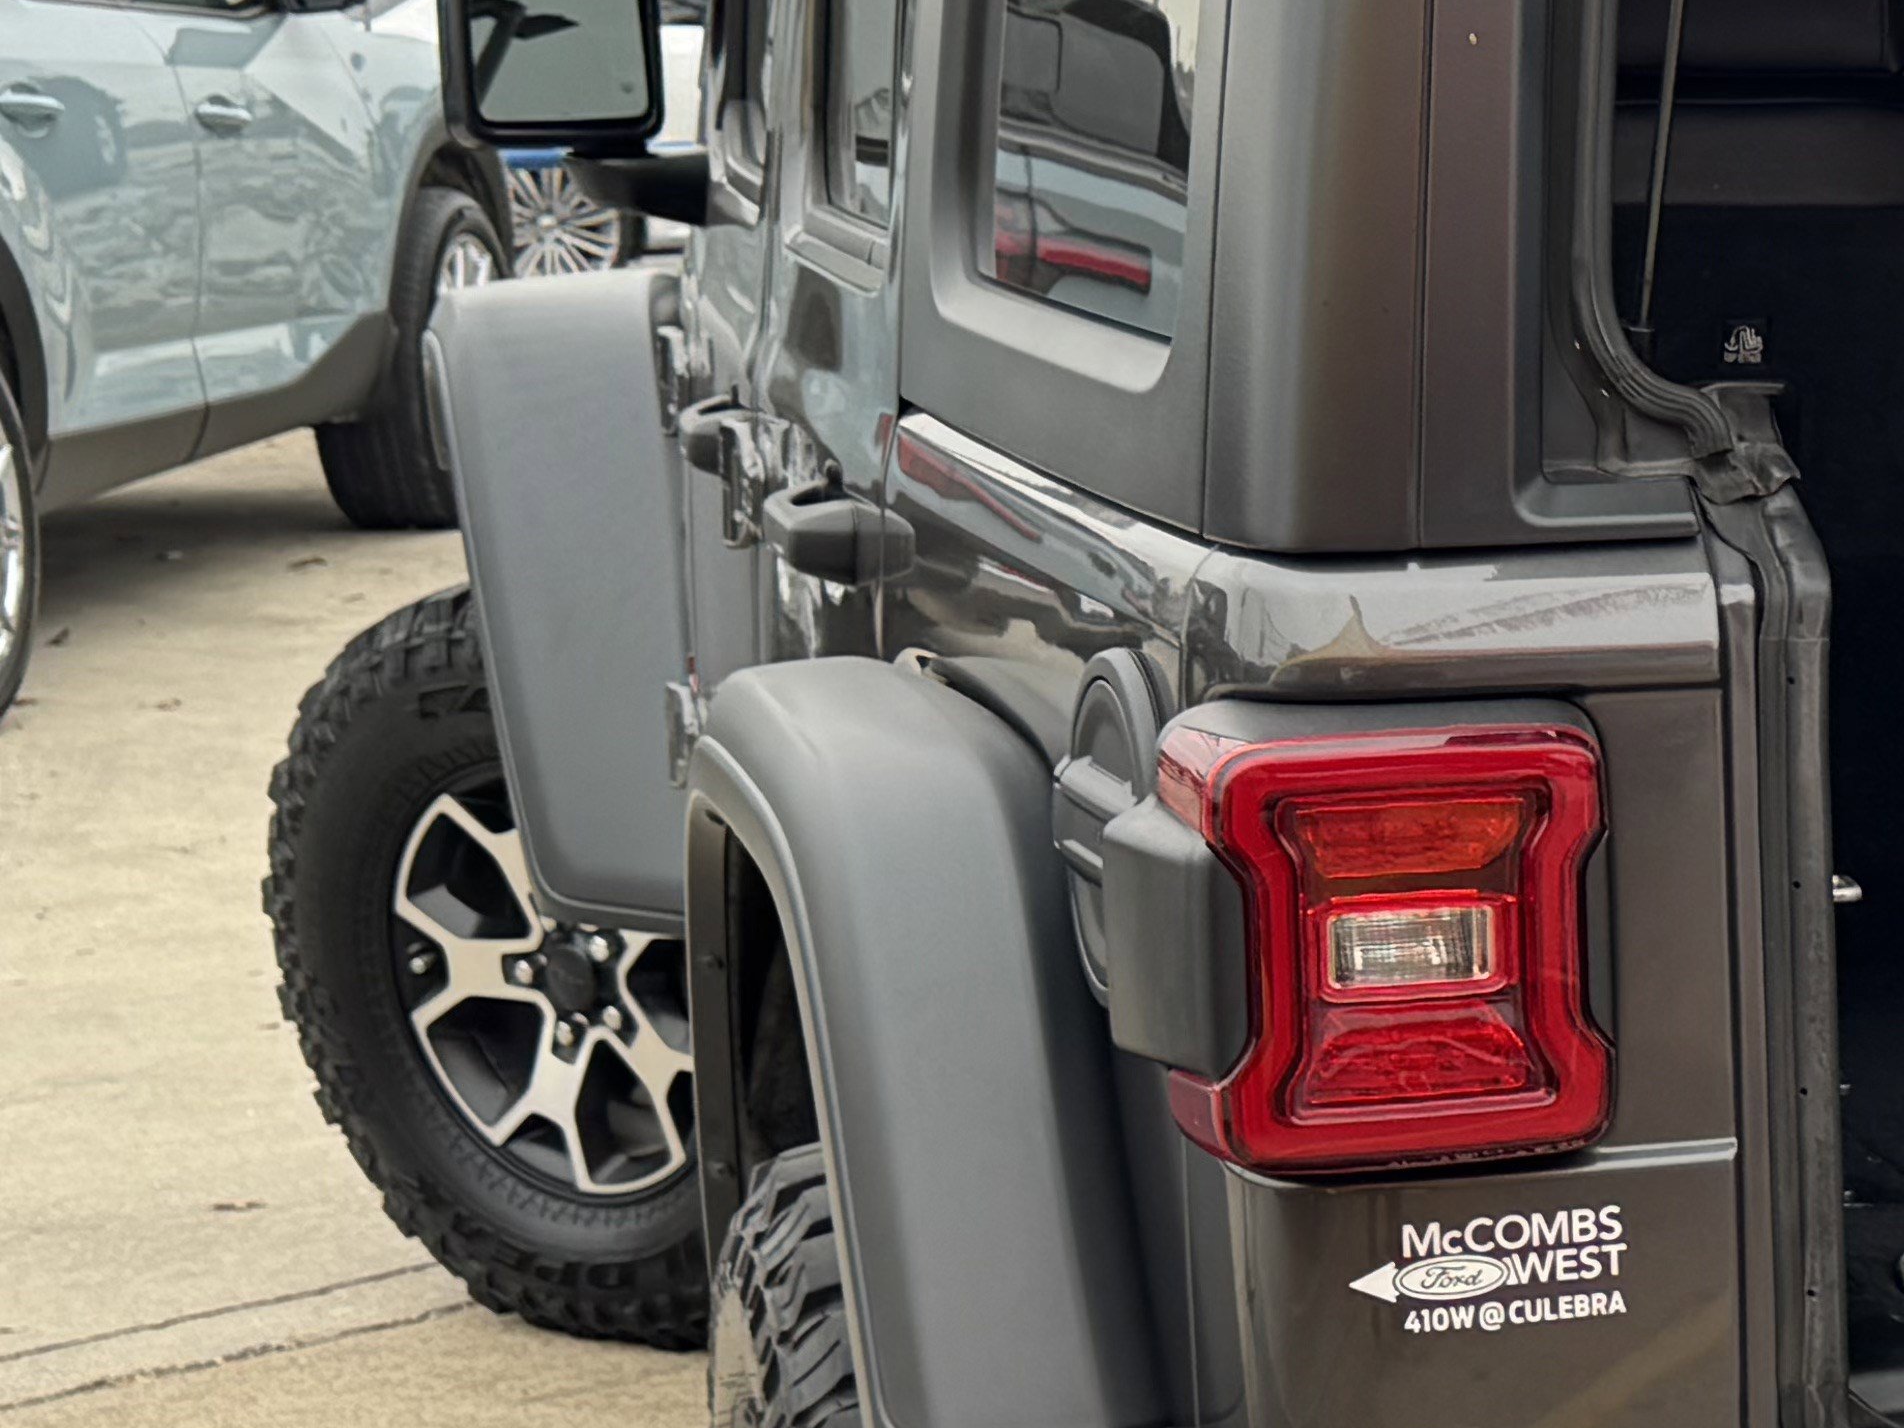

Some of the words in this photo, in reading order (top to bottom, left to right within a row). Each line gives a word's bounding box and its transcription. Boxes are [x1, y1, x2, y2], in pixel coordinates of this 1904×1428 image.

[1402, 1205, 1623, 1258] McCOMBS
[1420, 1265, 1483, 1289] Ford
[1511, 1243, 1628, 1284] WEST
[1508, 1290, 1627, 1324] CULEBRA
